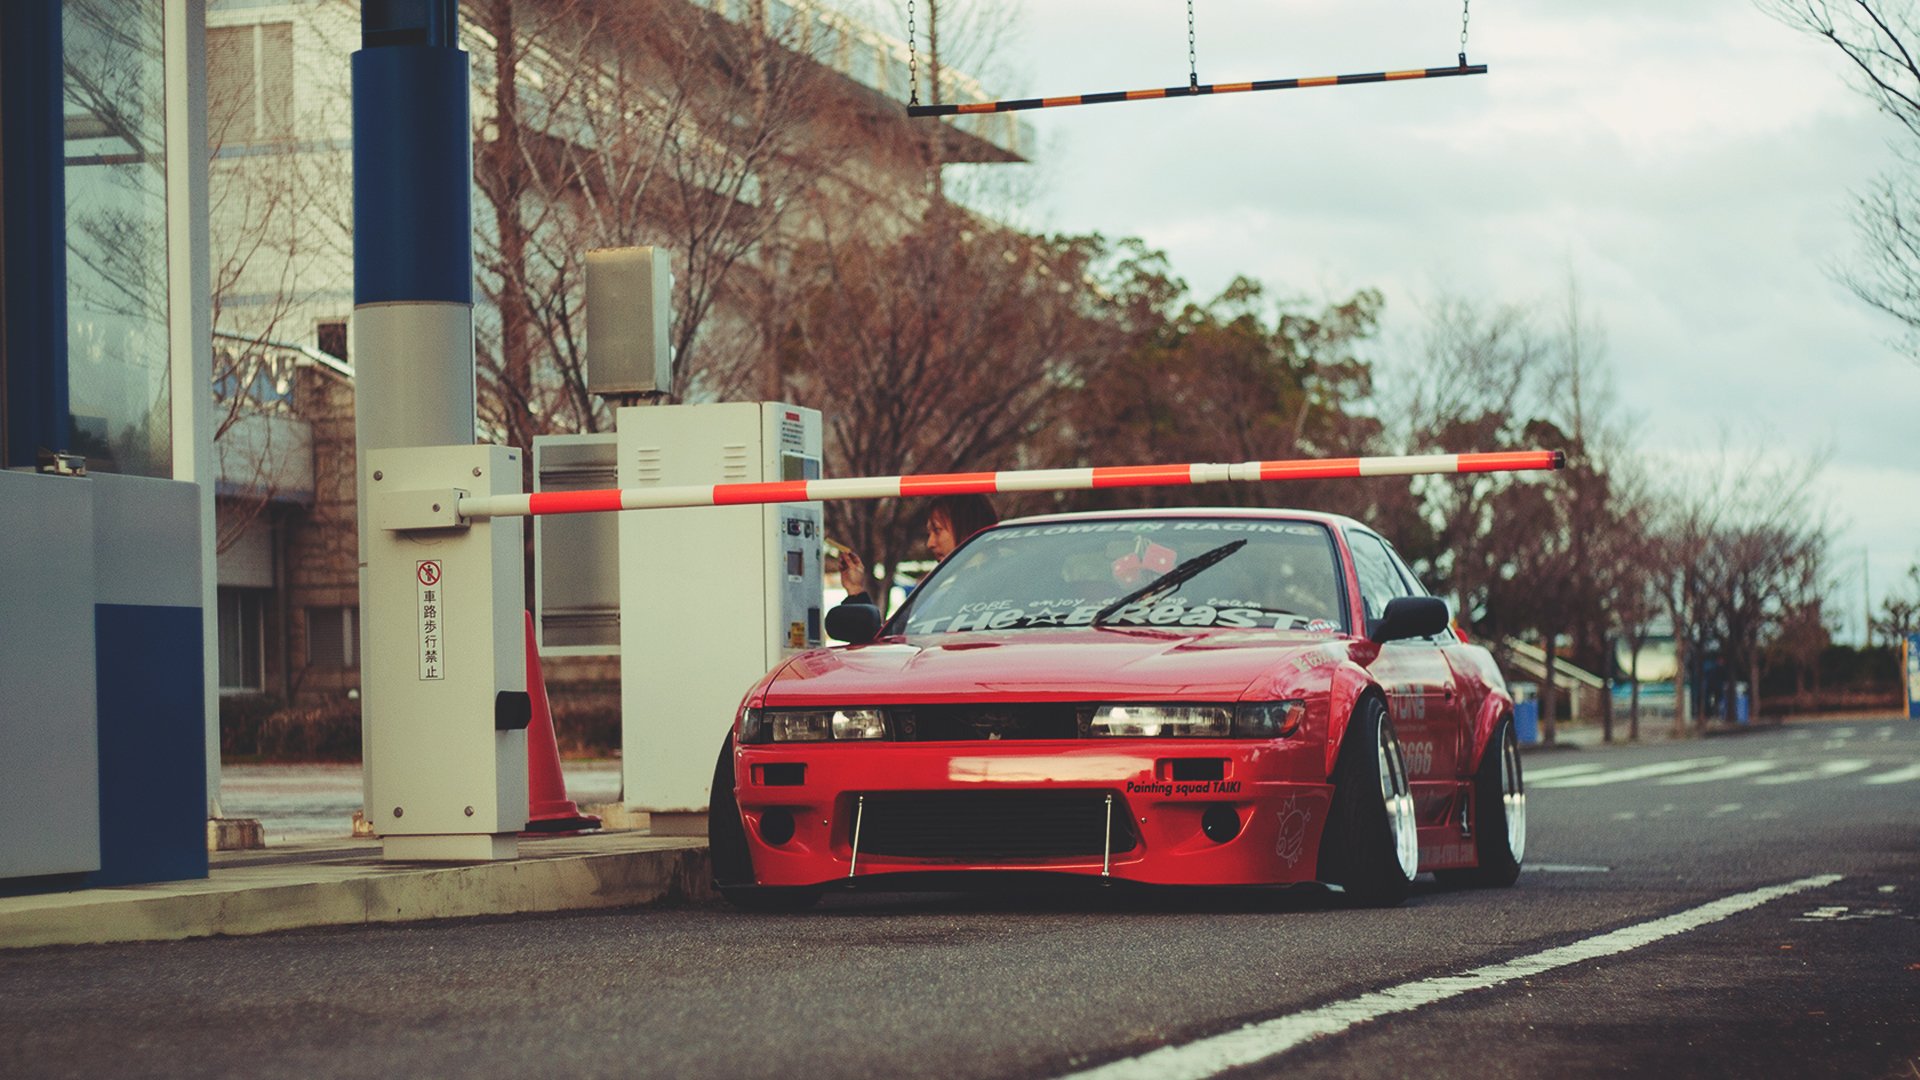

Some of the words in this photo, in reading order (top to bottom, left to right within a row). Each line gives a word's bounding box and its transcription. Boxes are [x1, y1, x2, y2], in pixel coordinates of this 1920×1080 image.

[958, 600, 1014, 614] KOBE
[1028, 598, 1085, 608] enjoy
[1207, 598, 1262, 609] team
[424, 590, 438, 678] 車路歩行禁止
[1126, 781, 1172, 796] Painting
[1175, 781, 1210, 796] squad
[1213, 781, 1241, 793] TAIKI
